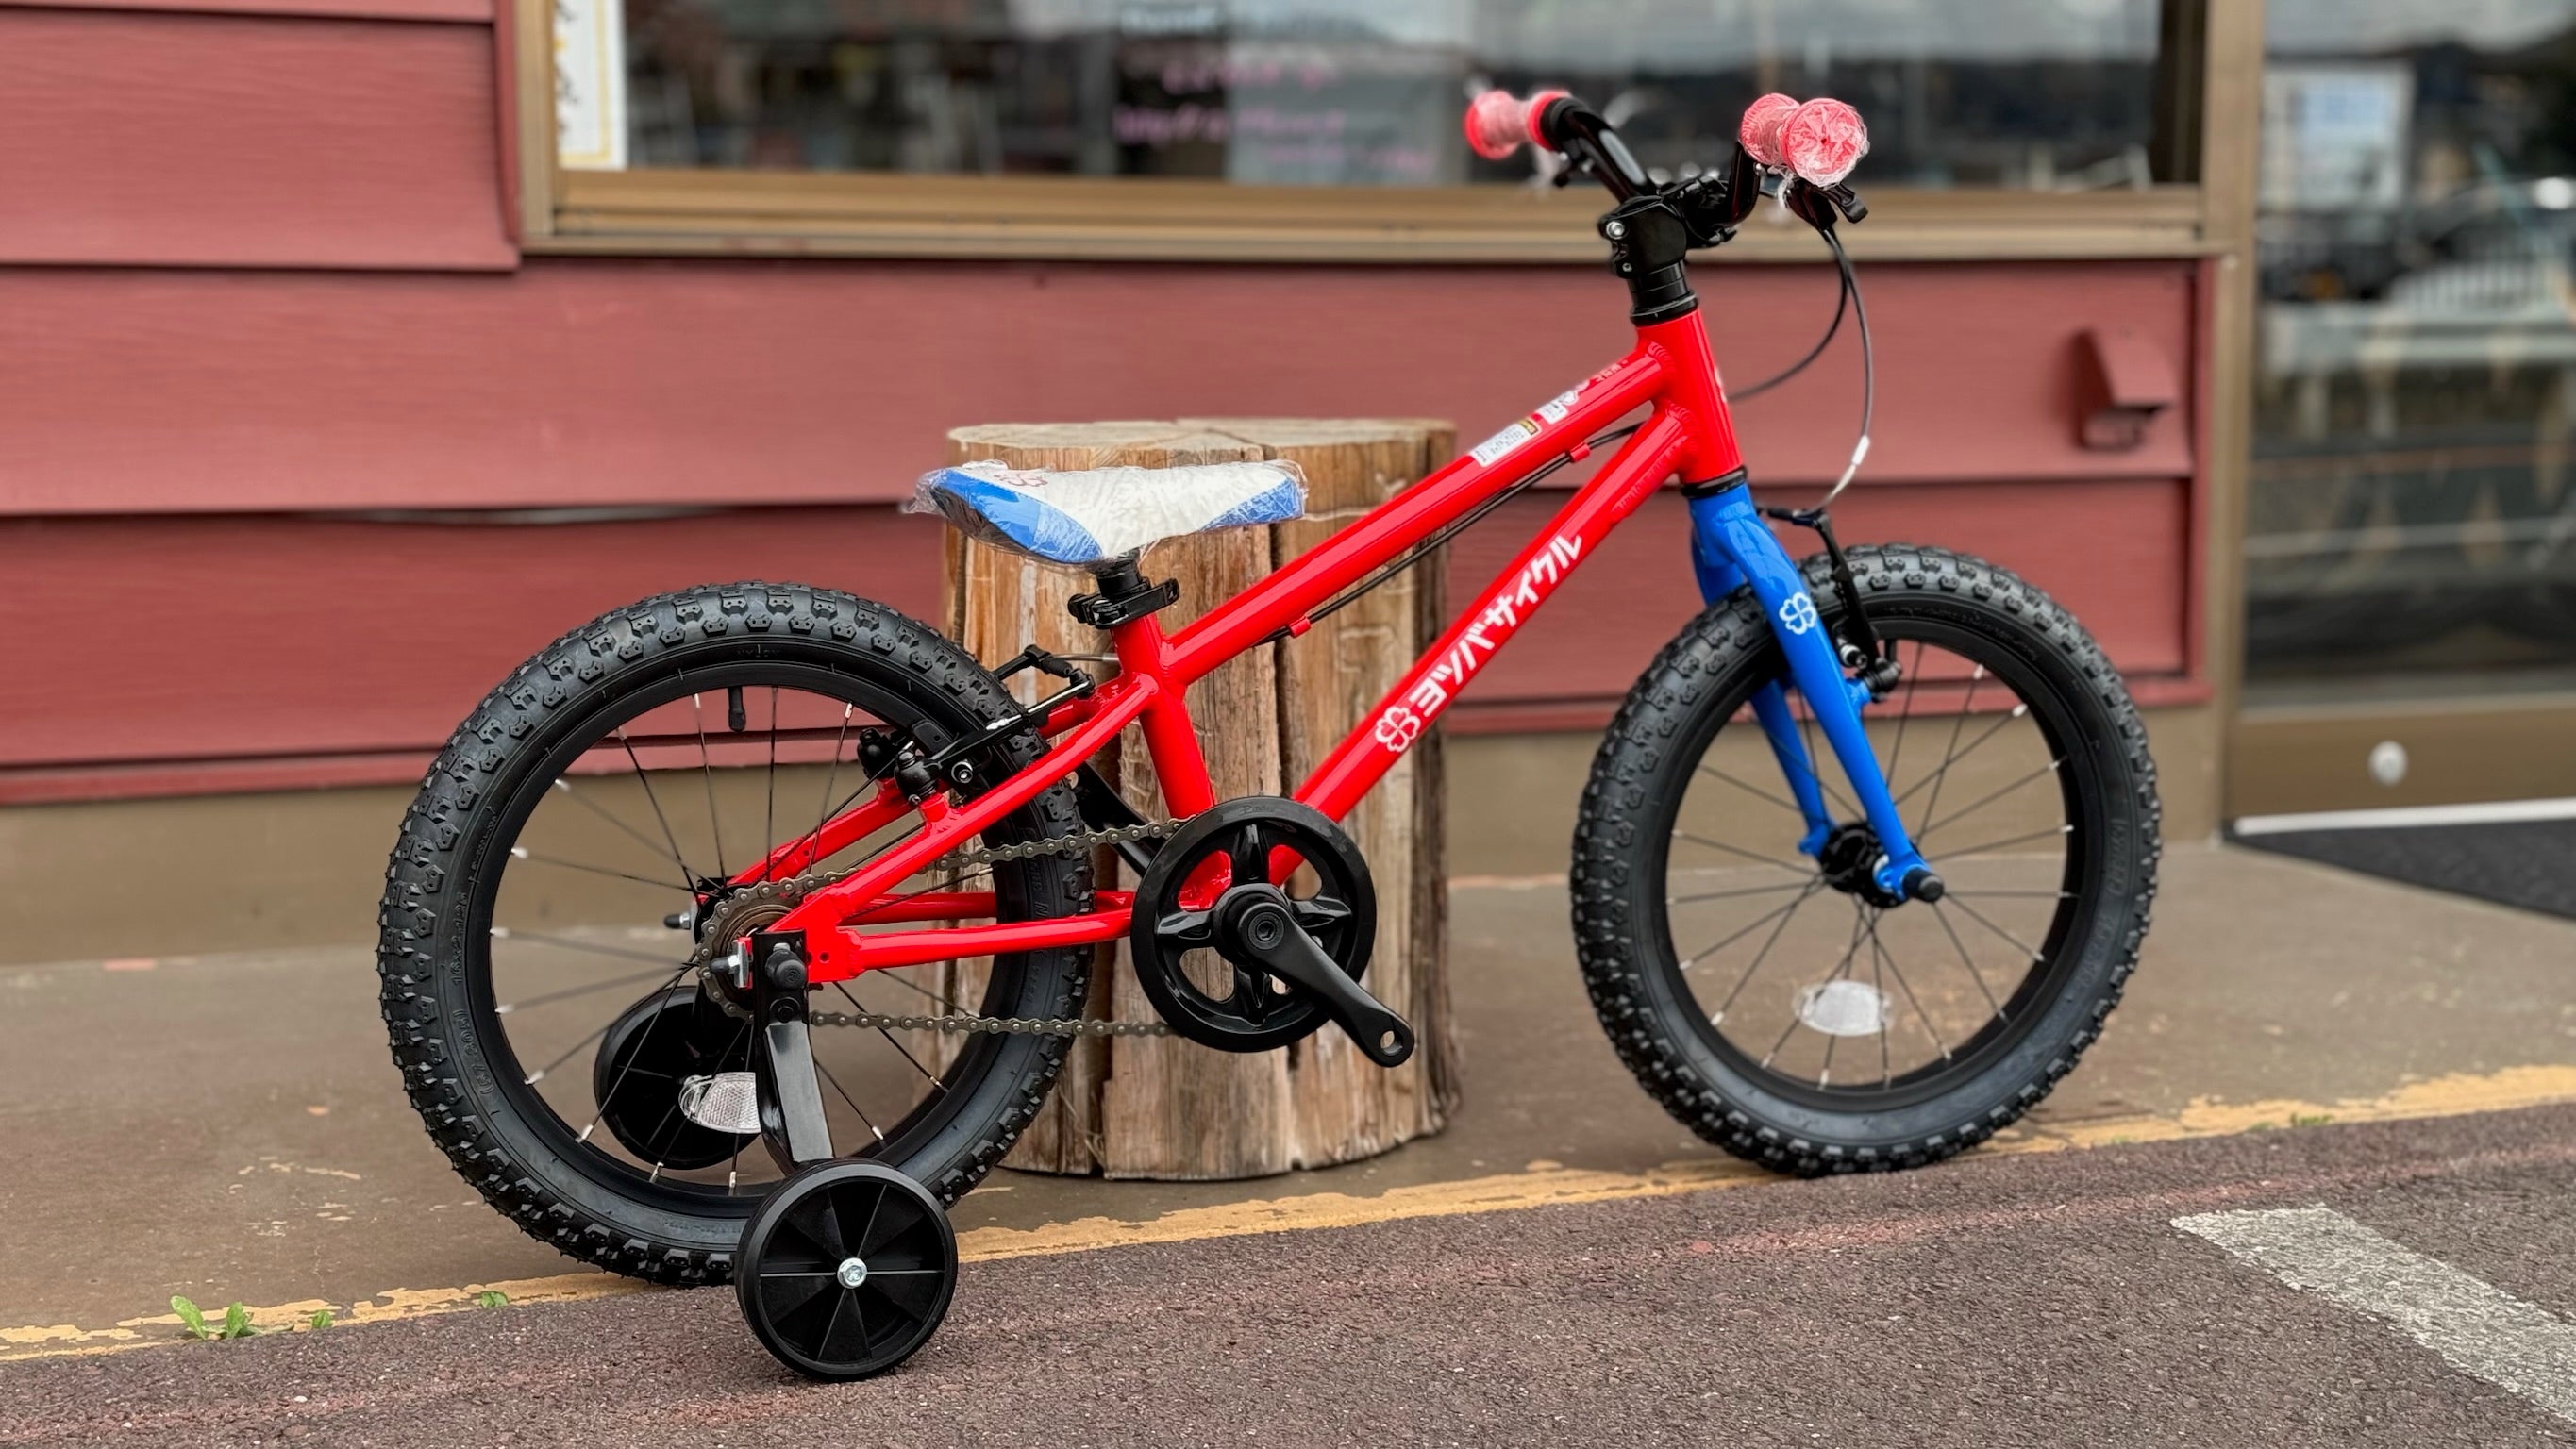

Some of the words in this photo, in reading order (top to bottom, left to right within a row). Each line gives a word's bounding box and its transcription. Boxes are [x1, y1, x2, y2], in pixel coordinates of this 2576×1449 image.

[1409, 535, 1582, 717] ヨツバサイクル
